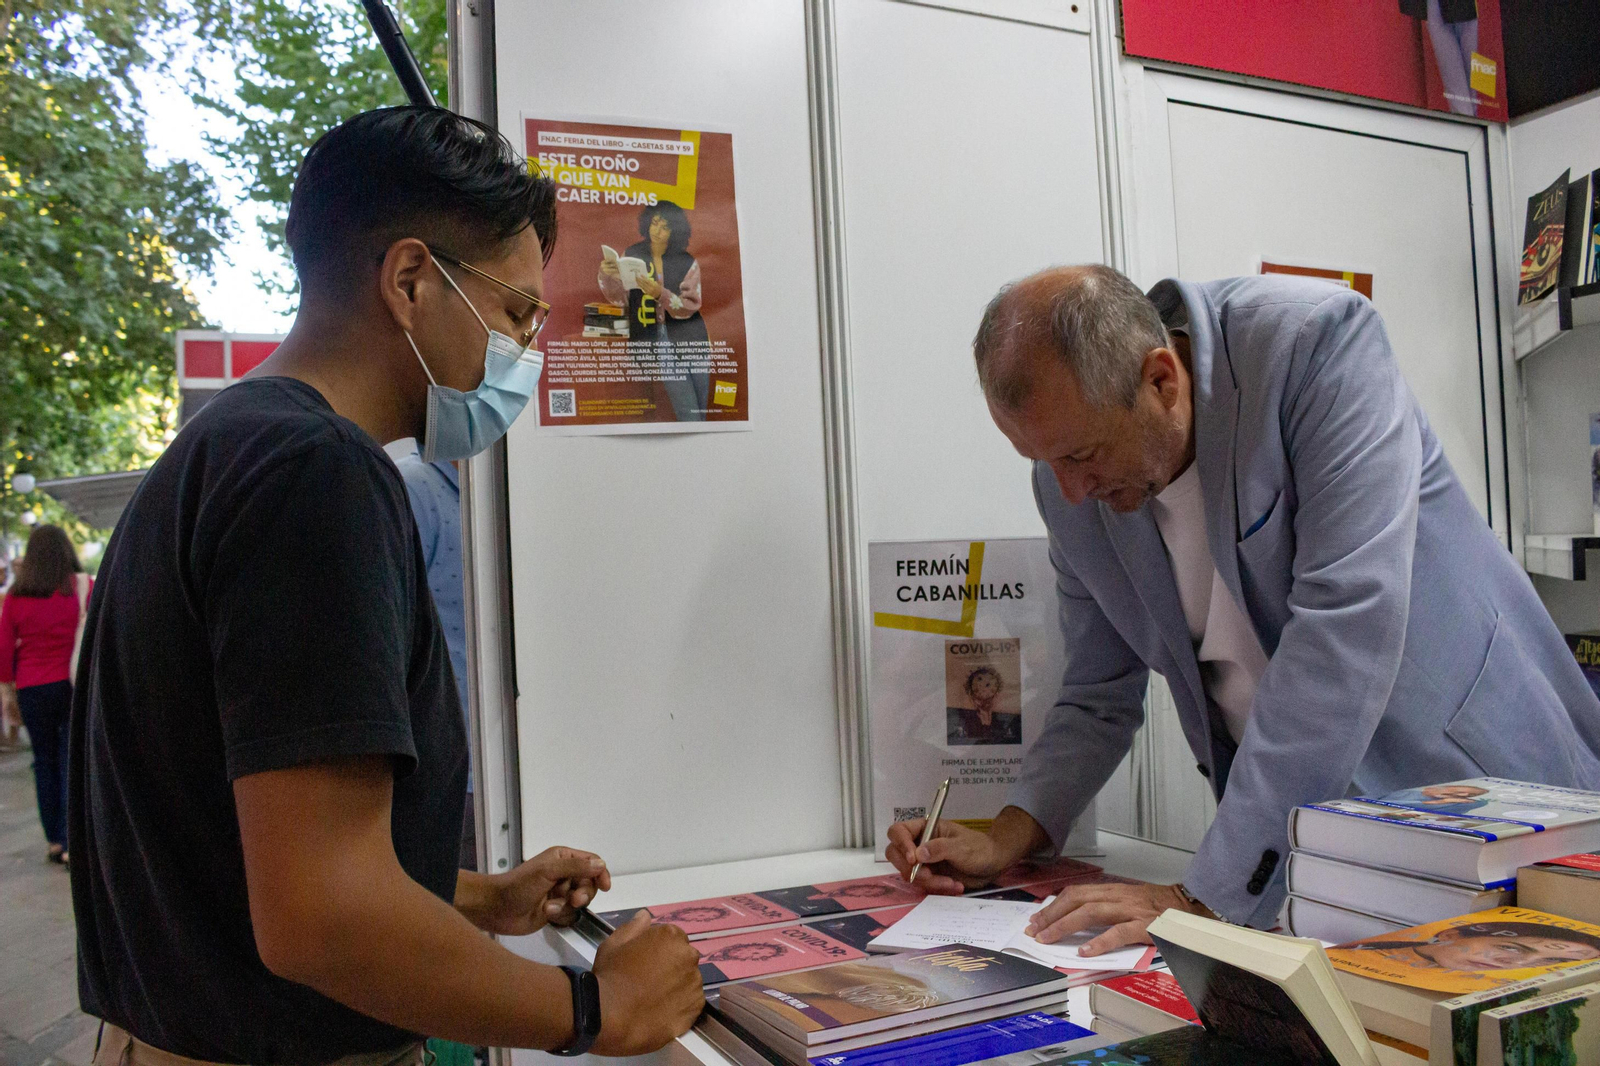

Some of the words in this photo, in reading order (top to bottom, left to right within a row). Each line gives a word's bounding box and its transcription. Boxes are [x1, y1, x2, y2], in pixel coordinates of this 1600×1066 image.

[1471, 58, 1497, 76] fnac
[541, 135, 562, 143] FNAC
[564, 137, 585, 145] FERIA
[602, 139, 624, 148] LIBRO
[631, 141, 664, 150] CASETAS
[538, 152, 577, 168] ESTE
[580, 154, 640, 172] OTOÑO
[559, 170, 593, 187] QUE
[596, 173, 630, 188] VAN
[557, 187, 600, 204] CAER
[604, 190, 658, 206] HOJAS
[715, 384, 737, 393] fnac
[896, 554, 970, 577] FERMÍN
[896, 582, 1025, 603] CABANILLAS
[941, 758, 965, 766] FIRMA
[967, 758, 977, 766] DE
[980, 757, 1023, 766] EJEMPLARE
[960, 767, 1000, 775] DOMINGO
[1002, 767, 1011, 775] 10
[950, 777, 960, 785] DE
[962, 777, 987, 785] 18:30H
[1499, 907, 1600, 938] VIRGE
[781, 929, 847, 957] COVID-19:
[1028, 1014, 1053, 1024] NADA
